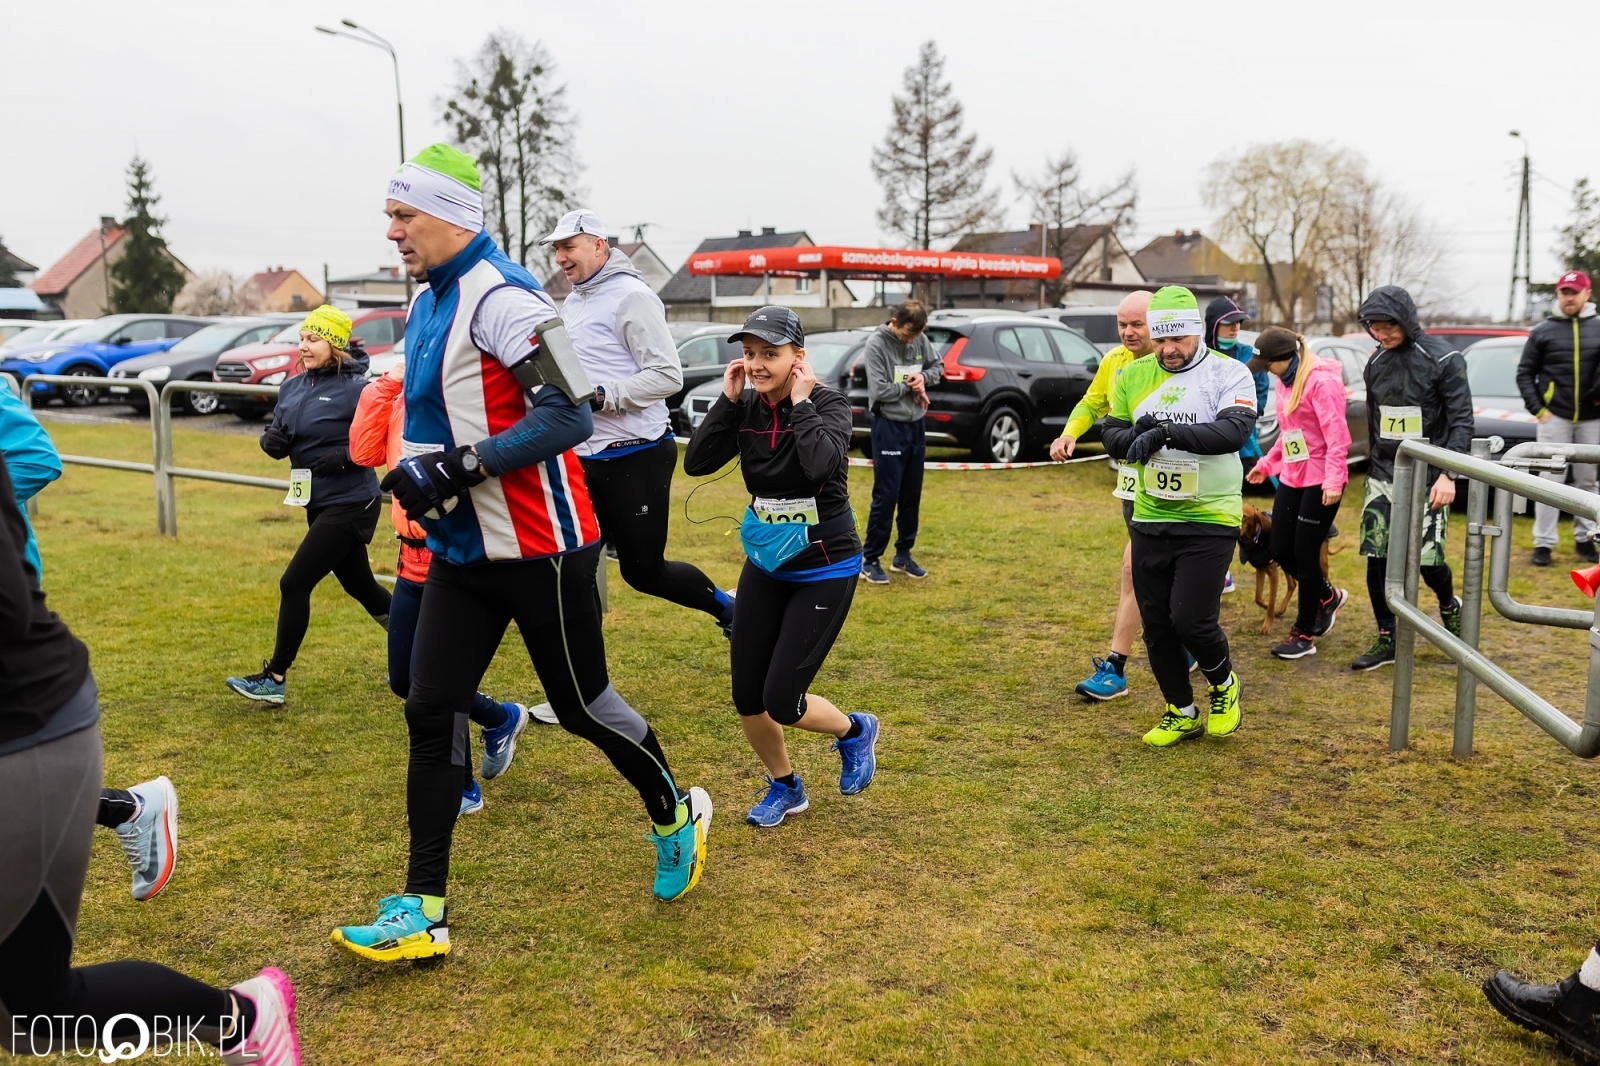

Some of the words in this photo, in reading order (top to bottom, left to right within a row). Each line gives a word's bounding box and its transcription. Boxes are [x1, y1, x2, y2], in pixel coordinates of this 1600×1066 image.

[1151, 322, 1185, 333] AKTYWNI
[1144, 411, 1197, 423] KYWNI
[1388, 418, 1406, 432] 71
[1121, 476, 1136, 492] 52
[1156, 471, 1182, 491] 95
